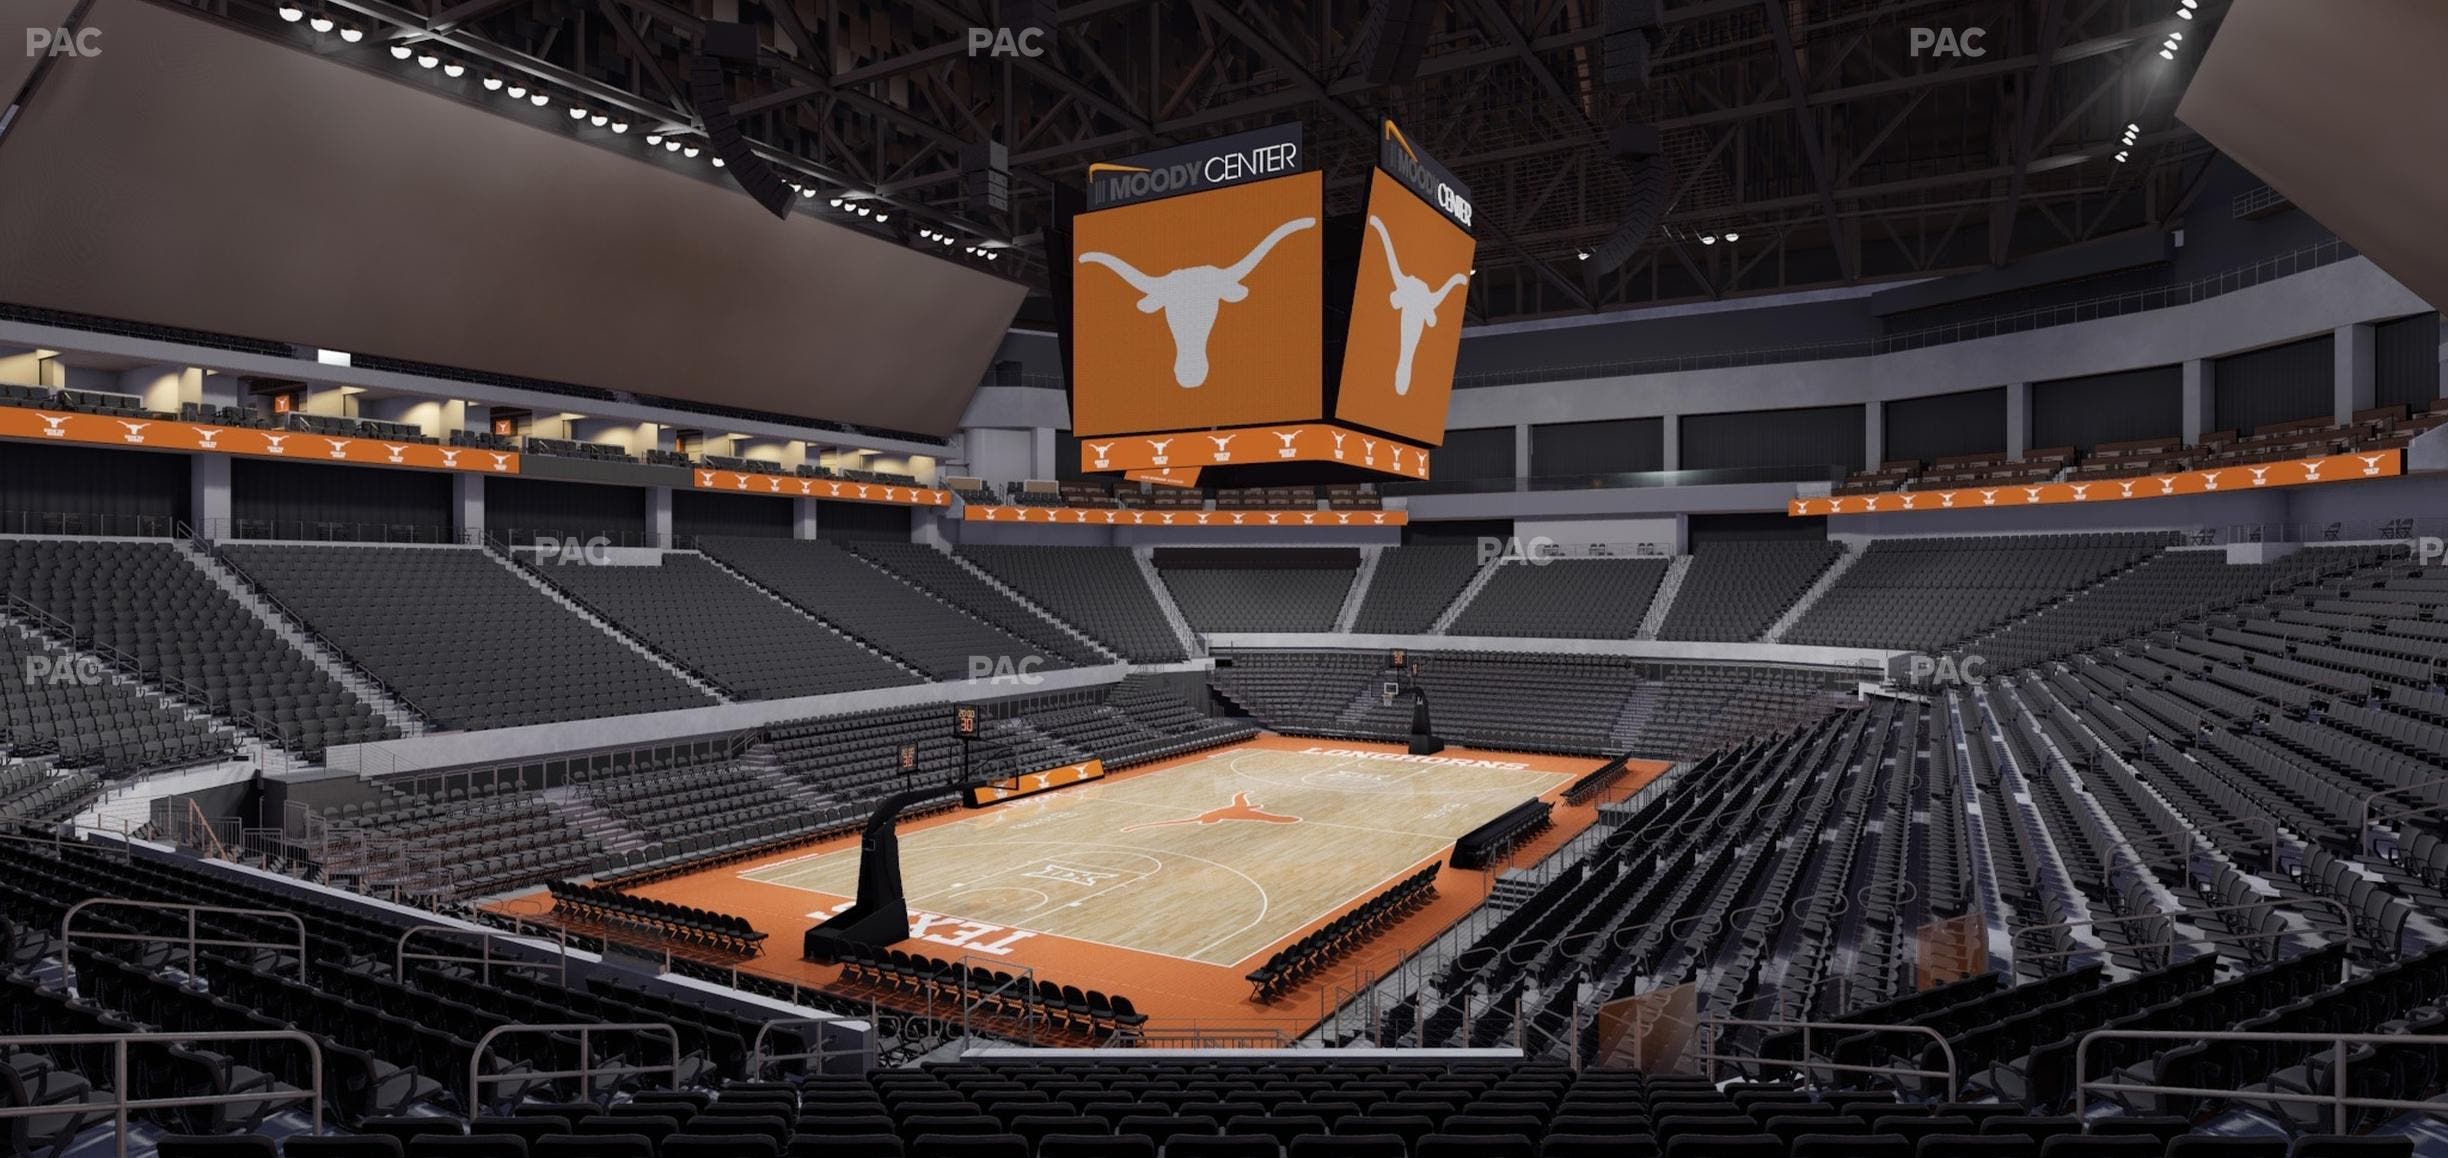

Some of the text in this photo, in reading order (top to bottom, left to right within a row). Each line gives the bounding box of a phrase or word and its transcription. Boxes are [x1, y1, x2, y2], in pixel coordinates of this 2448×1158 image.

[1110, 142, 1297, 201] MOODY CENTER
[1437, 182, 1472, 227] CENTER
[960, 718, 973, 732] 30
[1299, 747, 1530, 771] LONGHORNS
